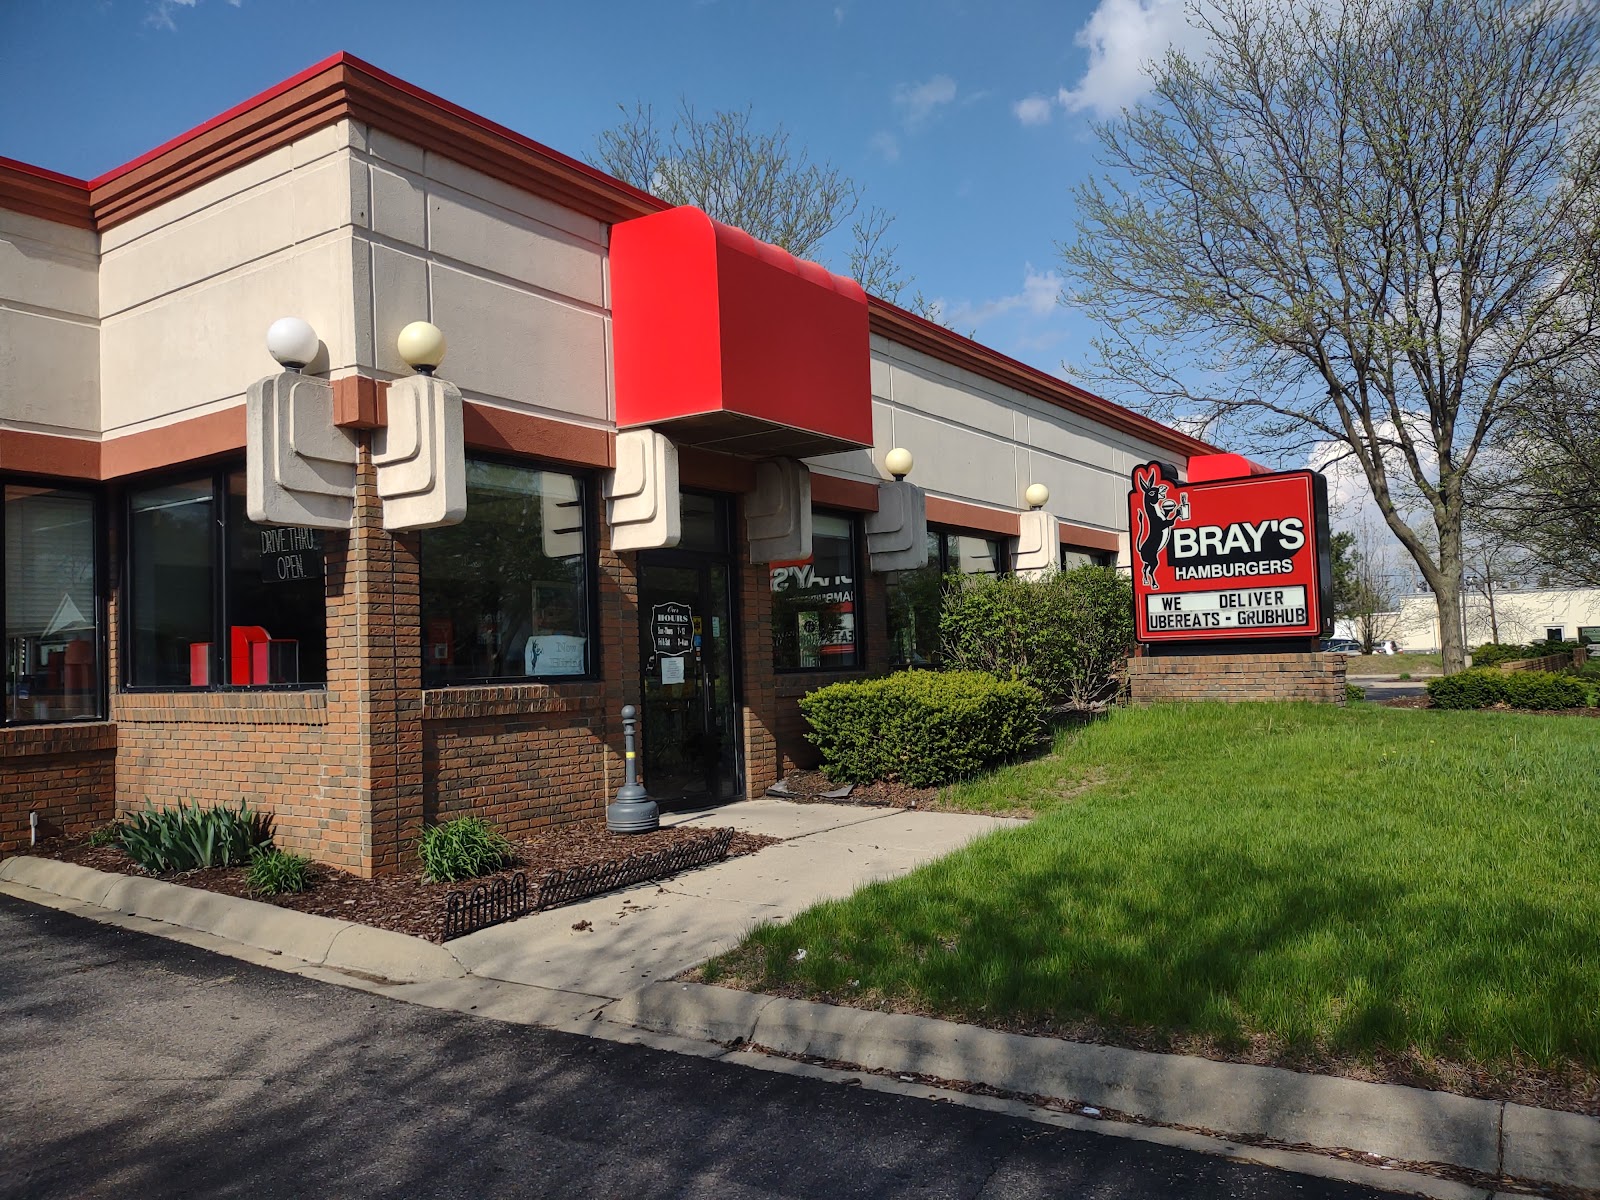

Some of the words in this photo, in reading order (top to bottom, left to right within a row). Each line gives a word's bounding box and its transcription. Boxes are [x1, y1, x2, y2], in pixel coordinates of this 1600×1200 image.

[261, 529, 289, 554] DRIVE
[288, 528, 314, 551] THRU
[1173, 518, 1305, 558] BRAY'S
[1175, 559, 1293, 580] HAMBURGERS
[1161, 596, 1182, 611] WE
[1219, 590, 1284, 609] DELIVER
[657, 614, 689, 623] HOURS
[1150, 612, 1220, 629] UBEREATS
[1237, 607, 1305, 625] GRUBHUB
[556, 642, 577, 653] Now
